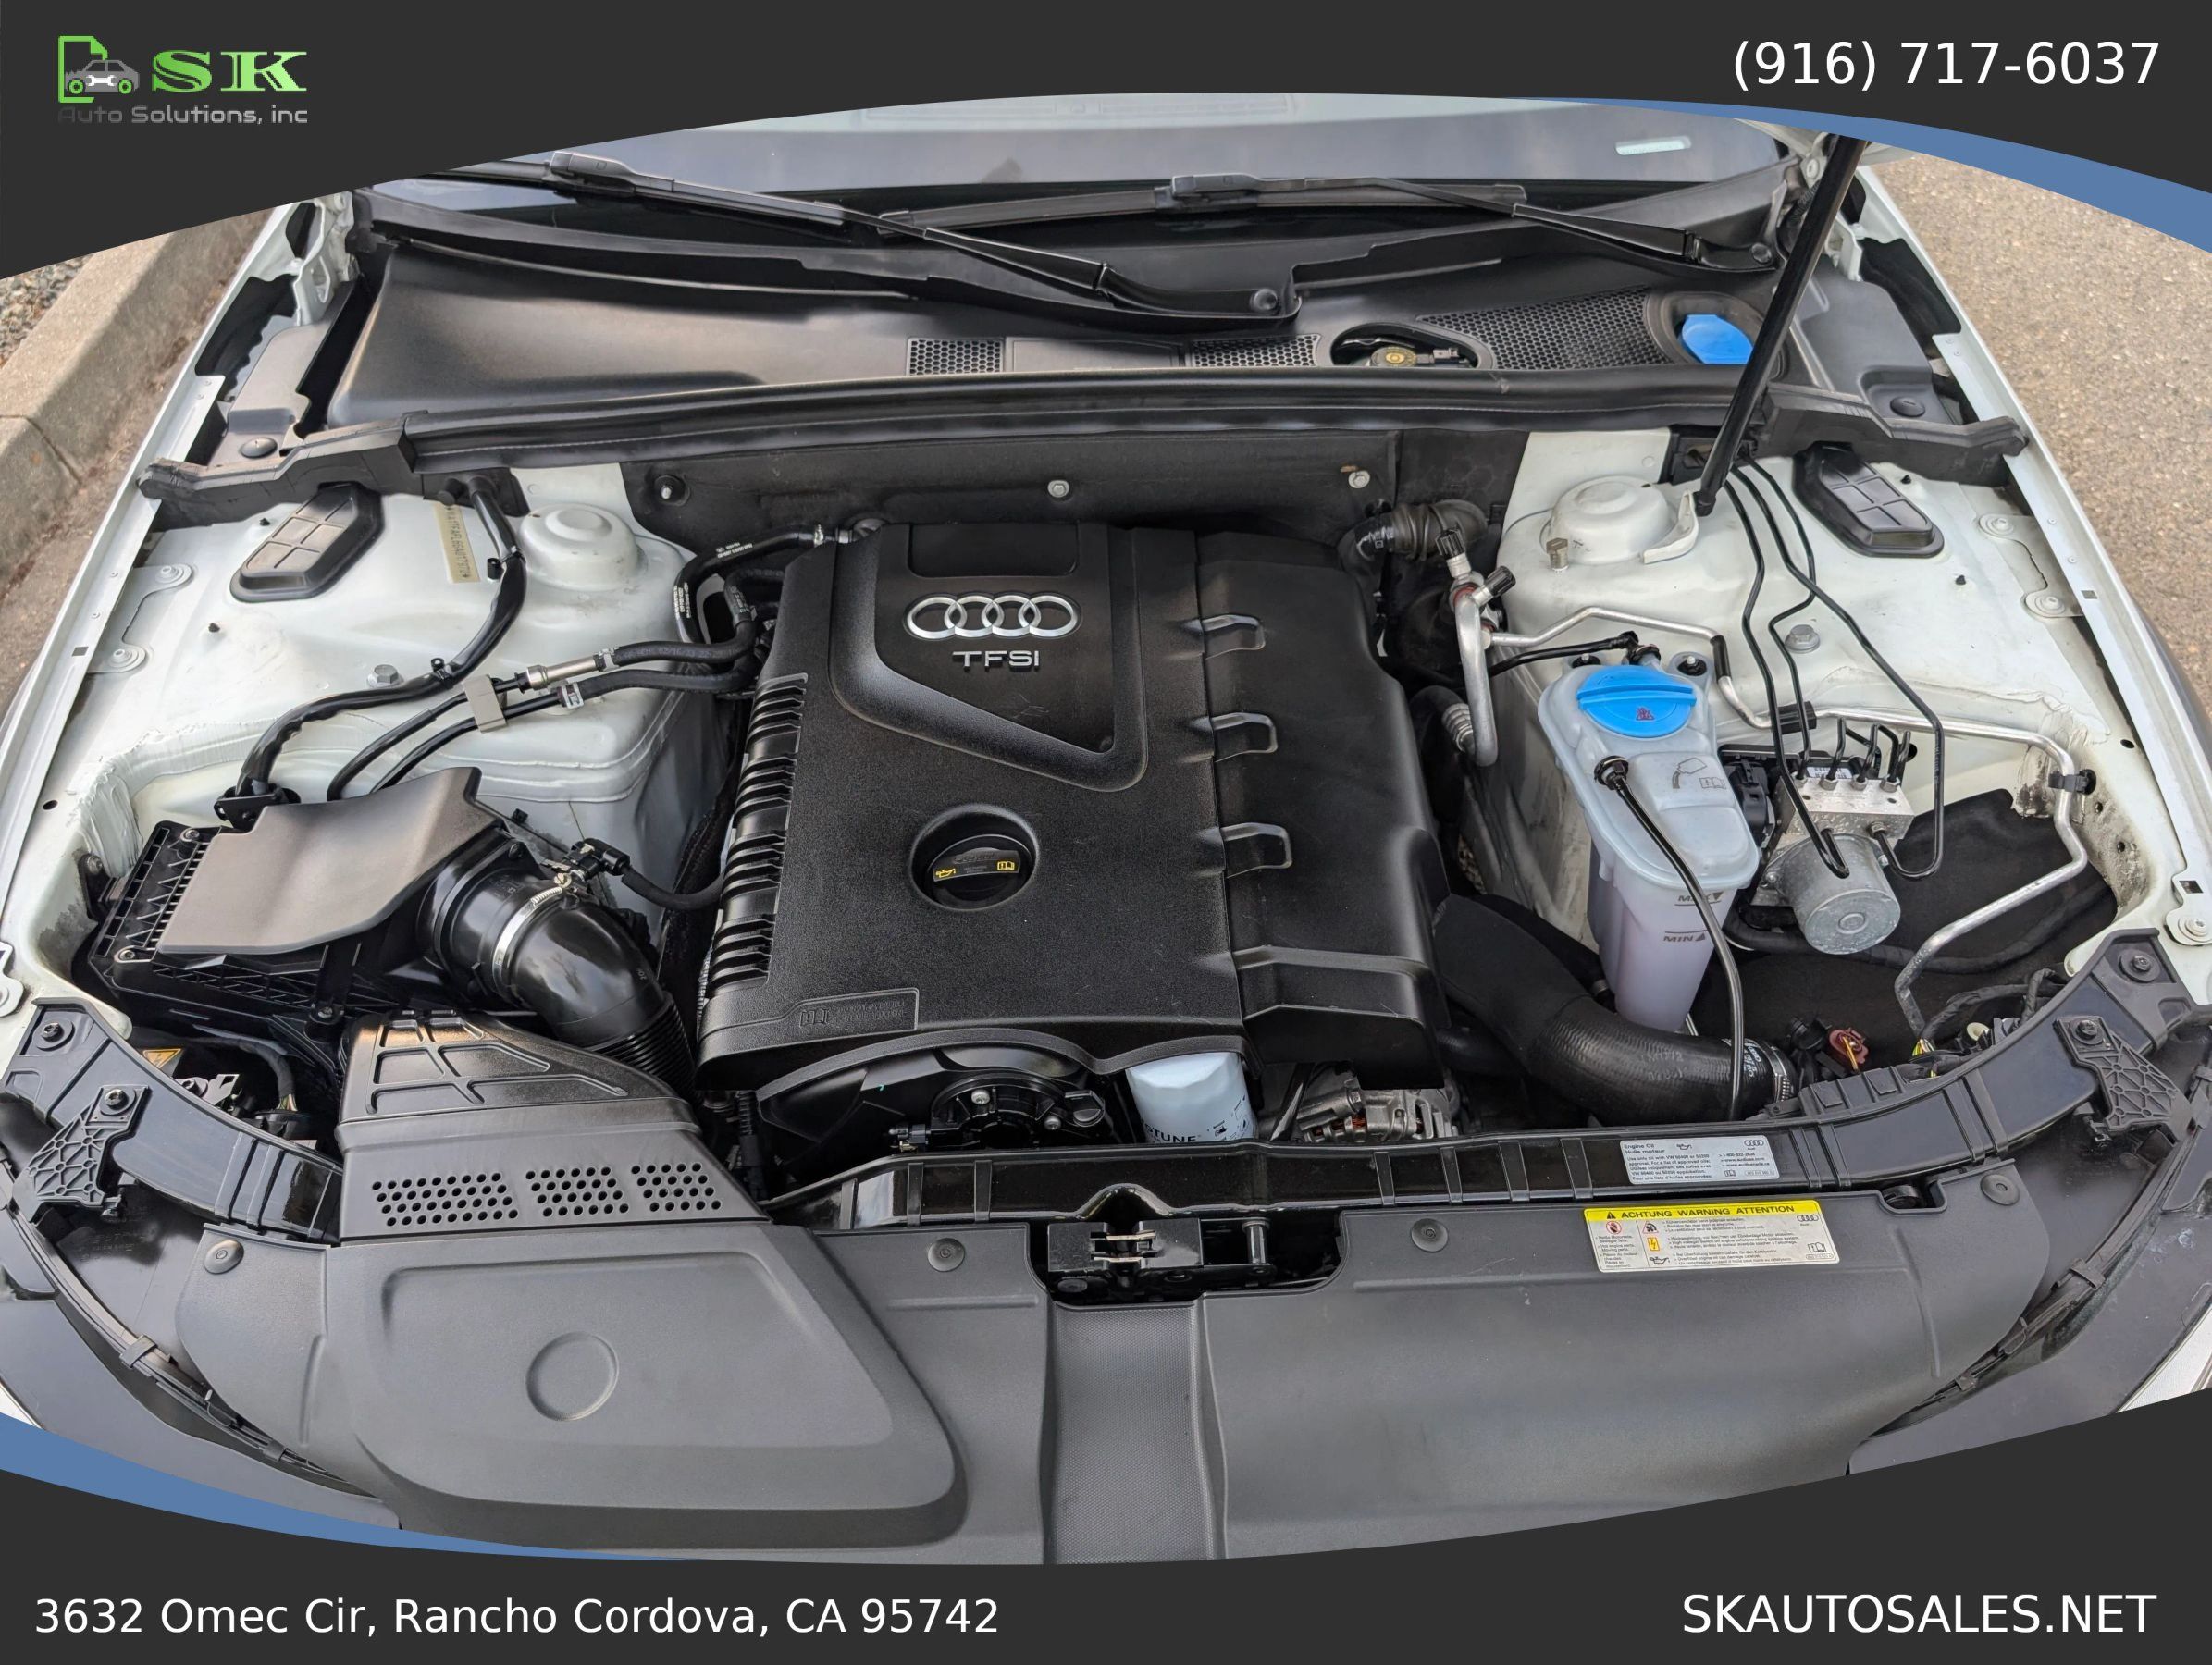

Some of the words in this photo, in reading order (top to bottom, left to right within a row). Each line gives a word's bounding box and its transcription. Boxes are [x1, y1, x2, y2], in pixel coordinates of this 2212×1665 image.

[952, 650, 1039, 667] TFSI
[1621, 1210, 1673, 1219] ACHTUNG
[1677, 1208, 1731, 1216] WARNING
[1736, 1205, 1795, 1215] ATTENTION
